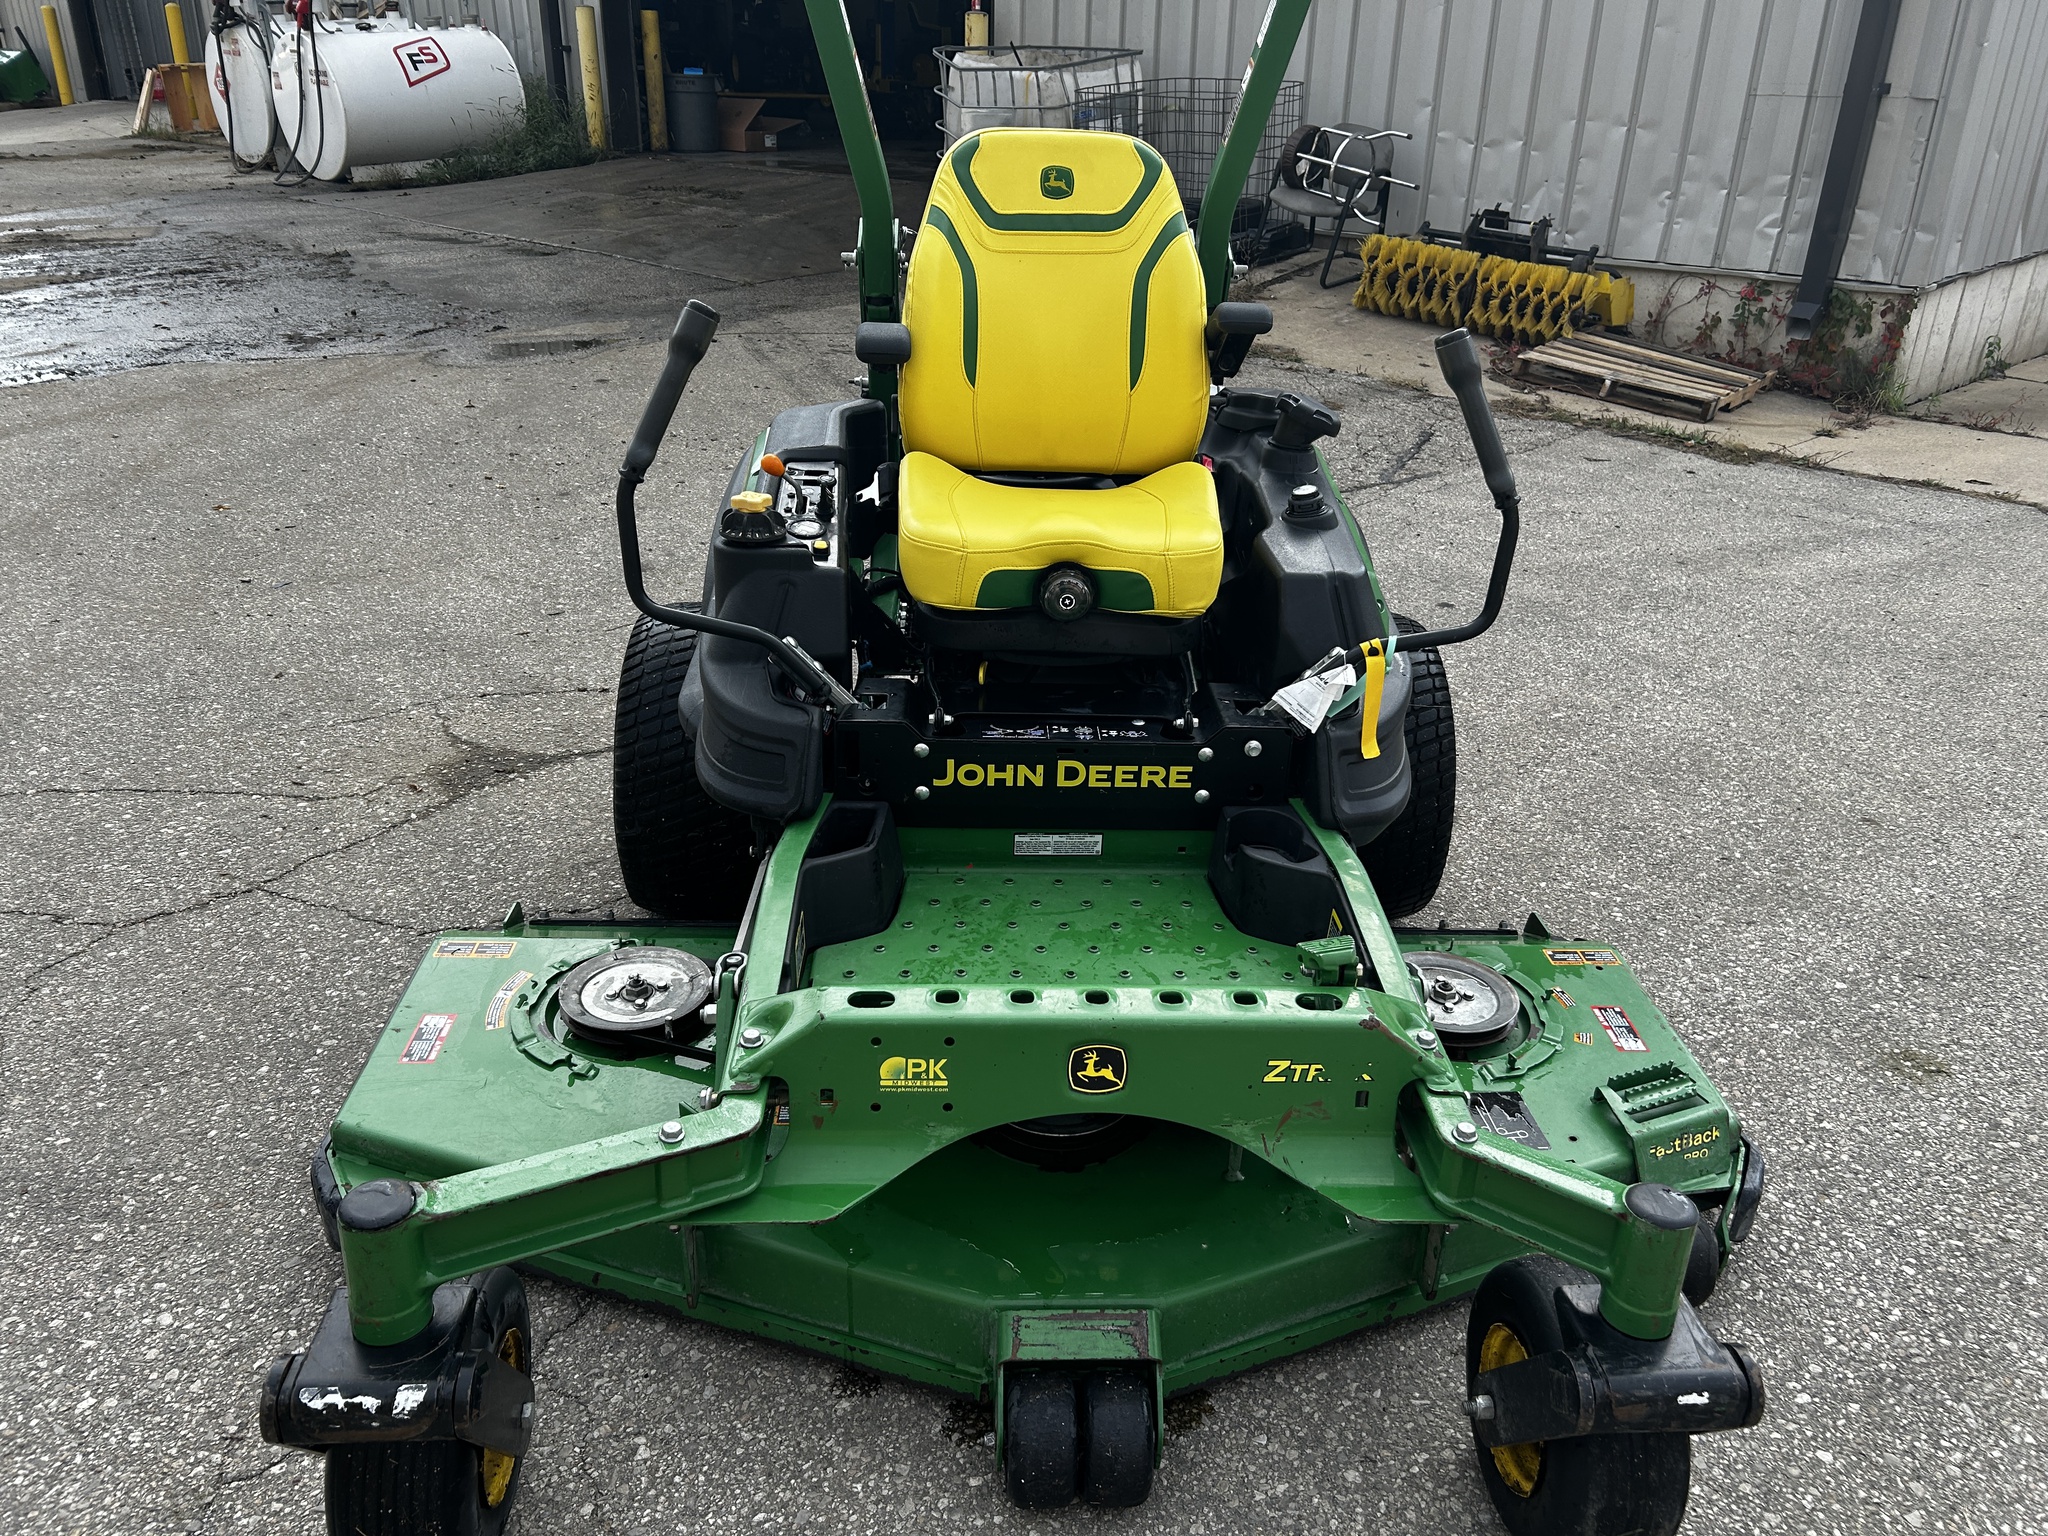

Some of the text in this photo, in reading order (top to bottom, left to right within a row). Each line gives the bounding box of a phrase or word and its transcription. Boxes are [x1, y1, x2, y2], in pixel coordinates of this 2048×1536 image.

[405, 45, 439, 72] FS
[932, 758, 1194, 789] JOHN DEERE
[907, 1058, 948, 1079] P&K
